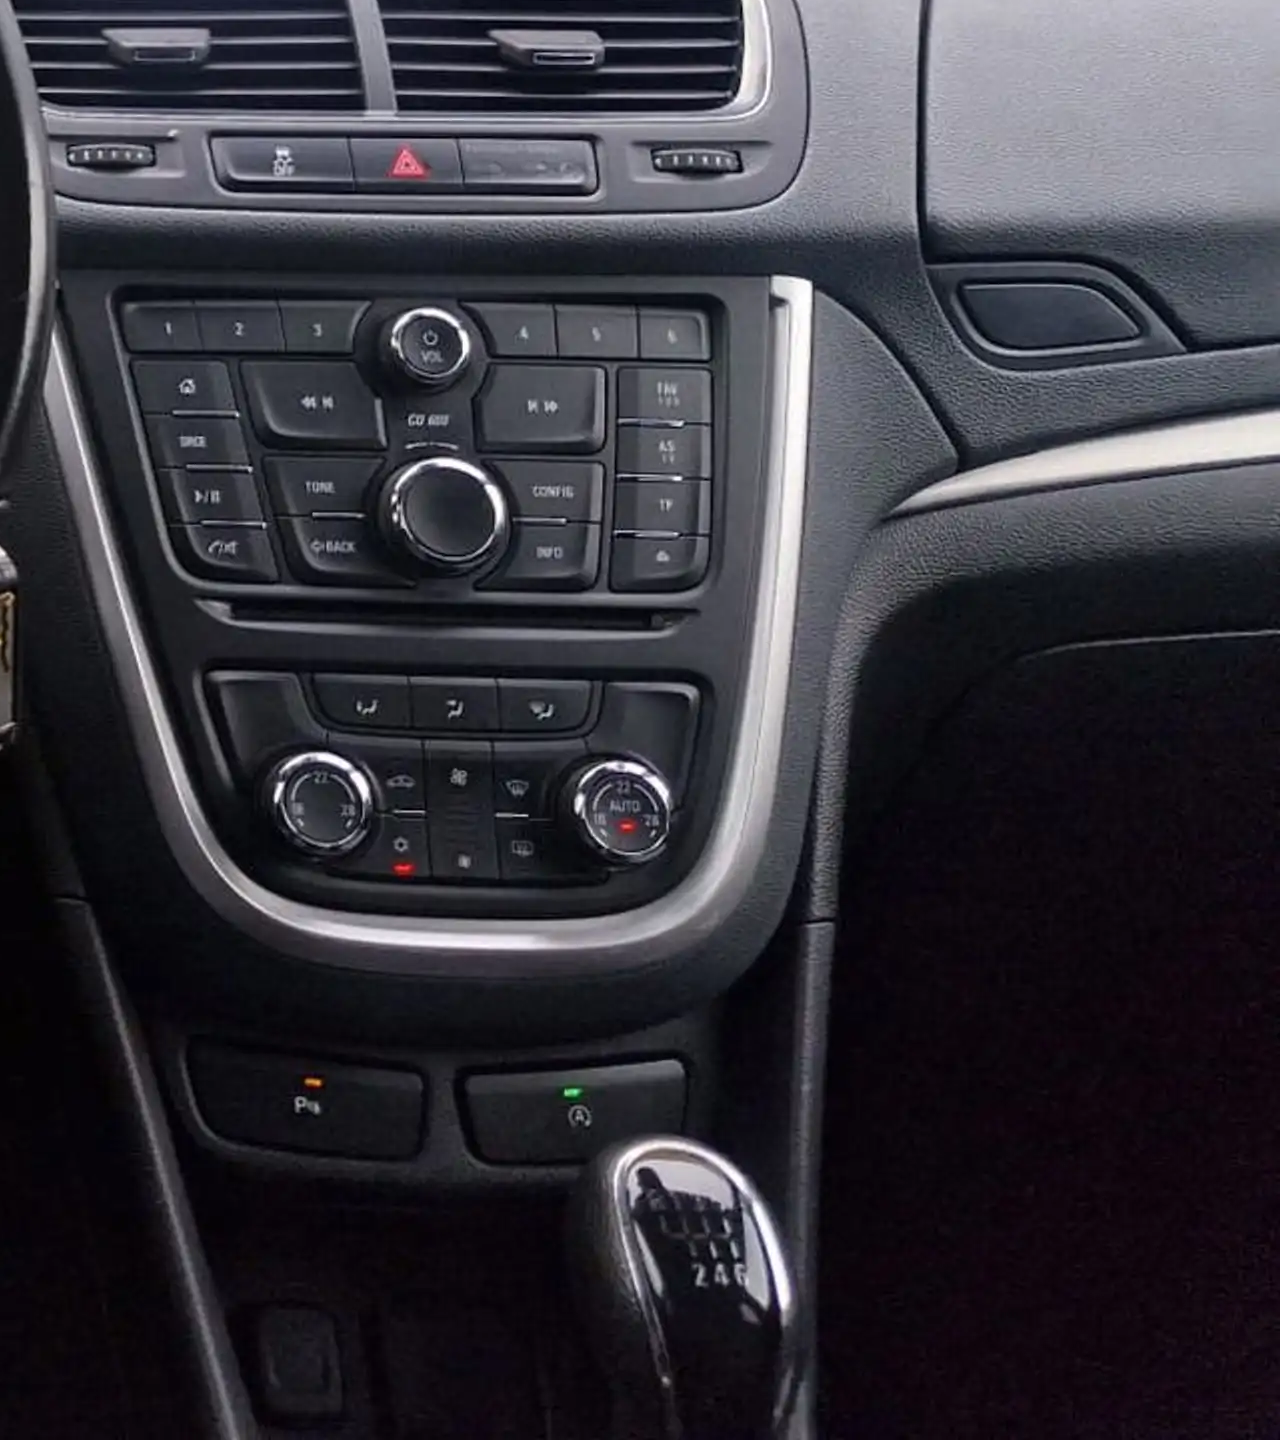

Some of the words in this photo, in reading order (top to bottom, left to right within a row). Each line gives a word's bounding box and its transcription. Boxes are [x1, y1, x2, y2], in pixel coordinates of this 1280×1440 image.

[165, 322, 172, 336] 1
[234, 322, 245, 336] 2
[313, 323, 322, 337] 3
[518, 326, 529, 340] 4
[592, 326, 601, 342] 5
[306, 481, 335, 494] TONE
[532, 486, 574, 499] CONFIG
[325, 541, 355, 554] BACK
[536, 545, 563, 559] INFO
[609, 800, 640, 812] AUTO
[692, 1263, 709, 1287] 2
[714, 1263, 730, 1287] 4
